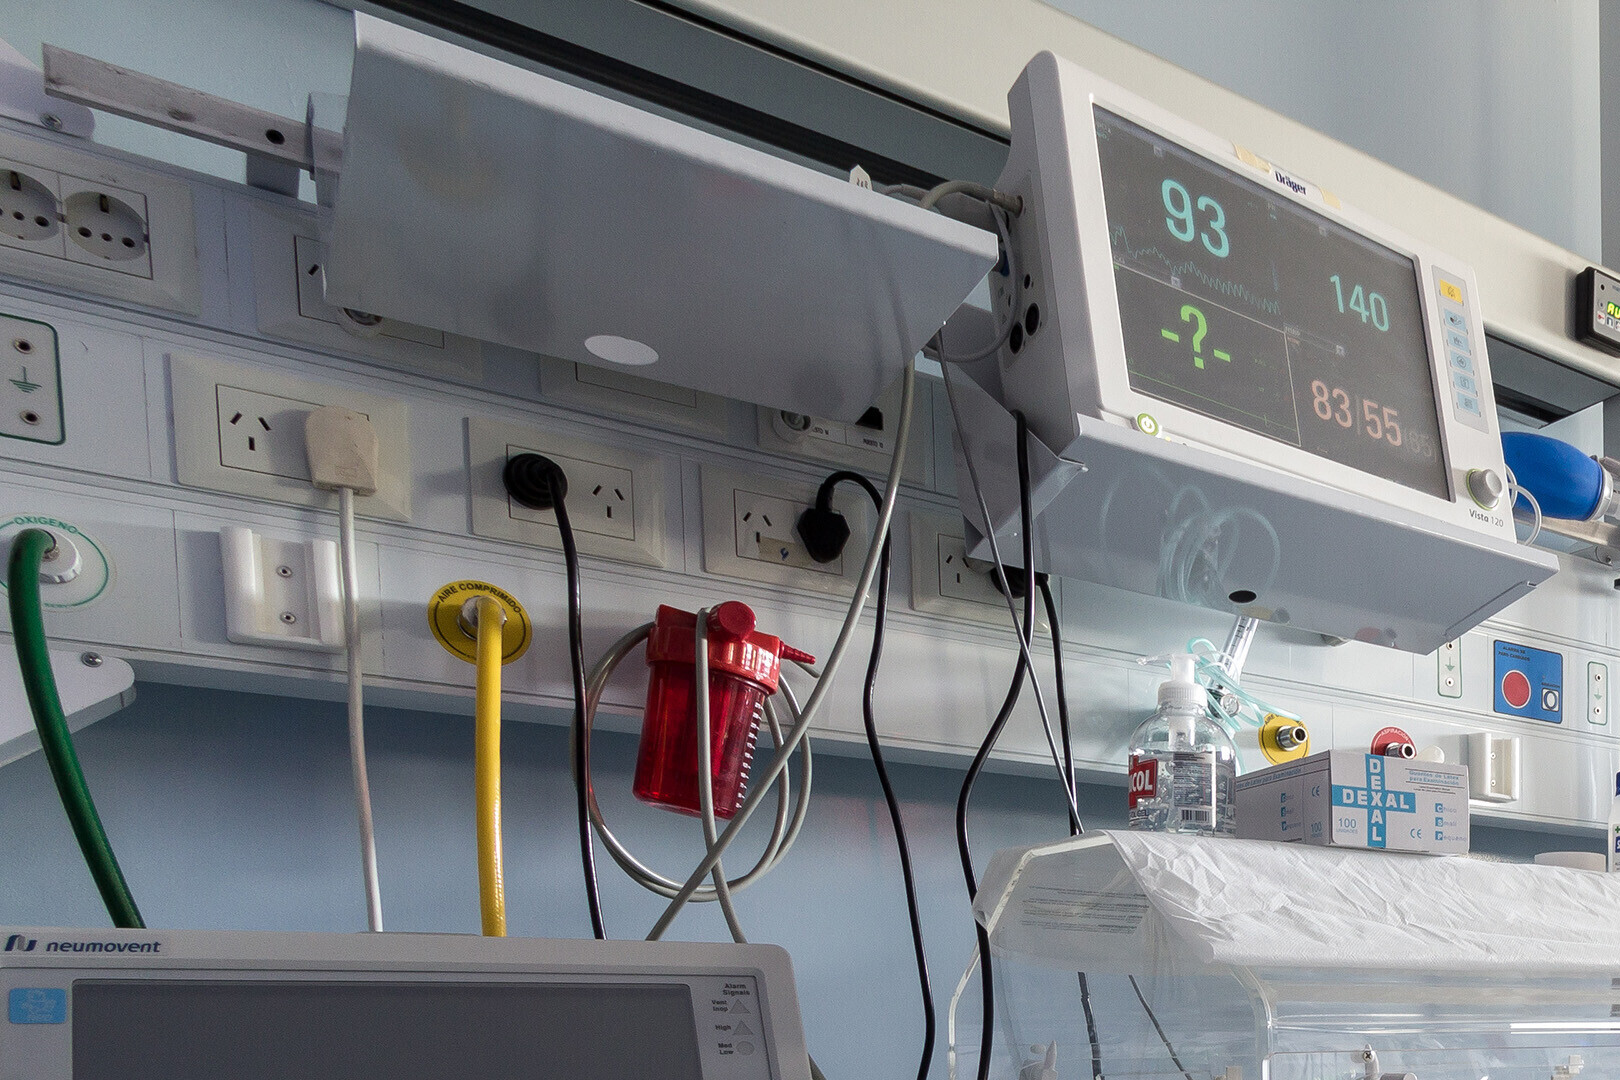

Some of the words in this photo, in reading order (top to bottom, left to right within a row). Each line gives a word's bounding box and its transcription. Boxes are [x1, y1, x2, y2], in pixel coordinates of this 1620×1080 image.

[1275, 170, 1306, 195] Dräger
[1162, 178, 1230, 258] 93
[1329, 274, 1389, 332] 140
[1469, 508, 1489, 523] Vista
[1490, 516, 1504, 528] 120
[437, 585, 458, 602] AIRE
[459, 582, 522, 613] COMPRIMIDO
[1342, 788, 1410, 810] DEXAL
[1369, 758, 1383, 841] DEXAL
[1338, 817, 1357, 829] 100
[45, 941, 162, 953] neumovent
